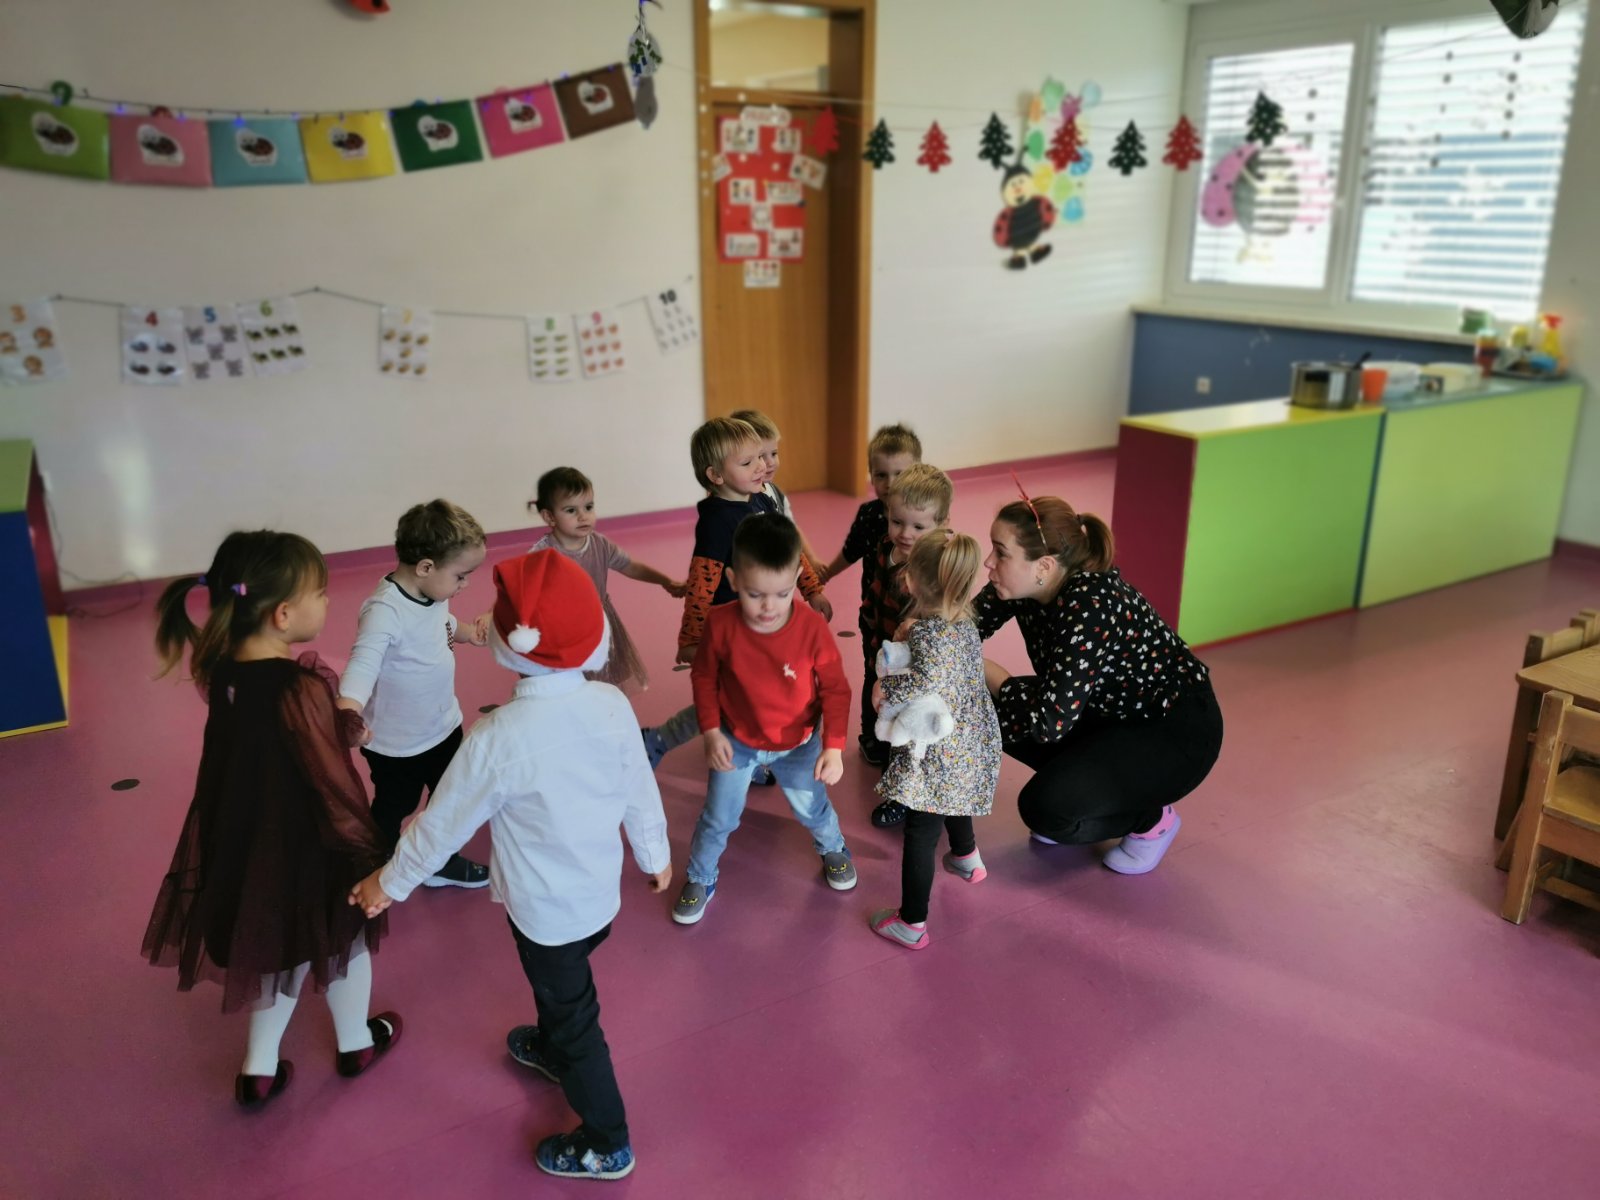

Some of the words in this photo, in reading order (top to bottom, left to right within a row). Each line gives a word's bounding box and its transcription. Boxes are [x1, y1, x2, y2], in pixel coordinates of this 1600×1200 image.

[659, 289, 676, 305] 10
[11, 304, 26, 323] 3
[204, 307, 216, 323] 5
[260, 300, 272, 317] 6
[146, 311, 158, 326] 4
